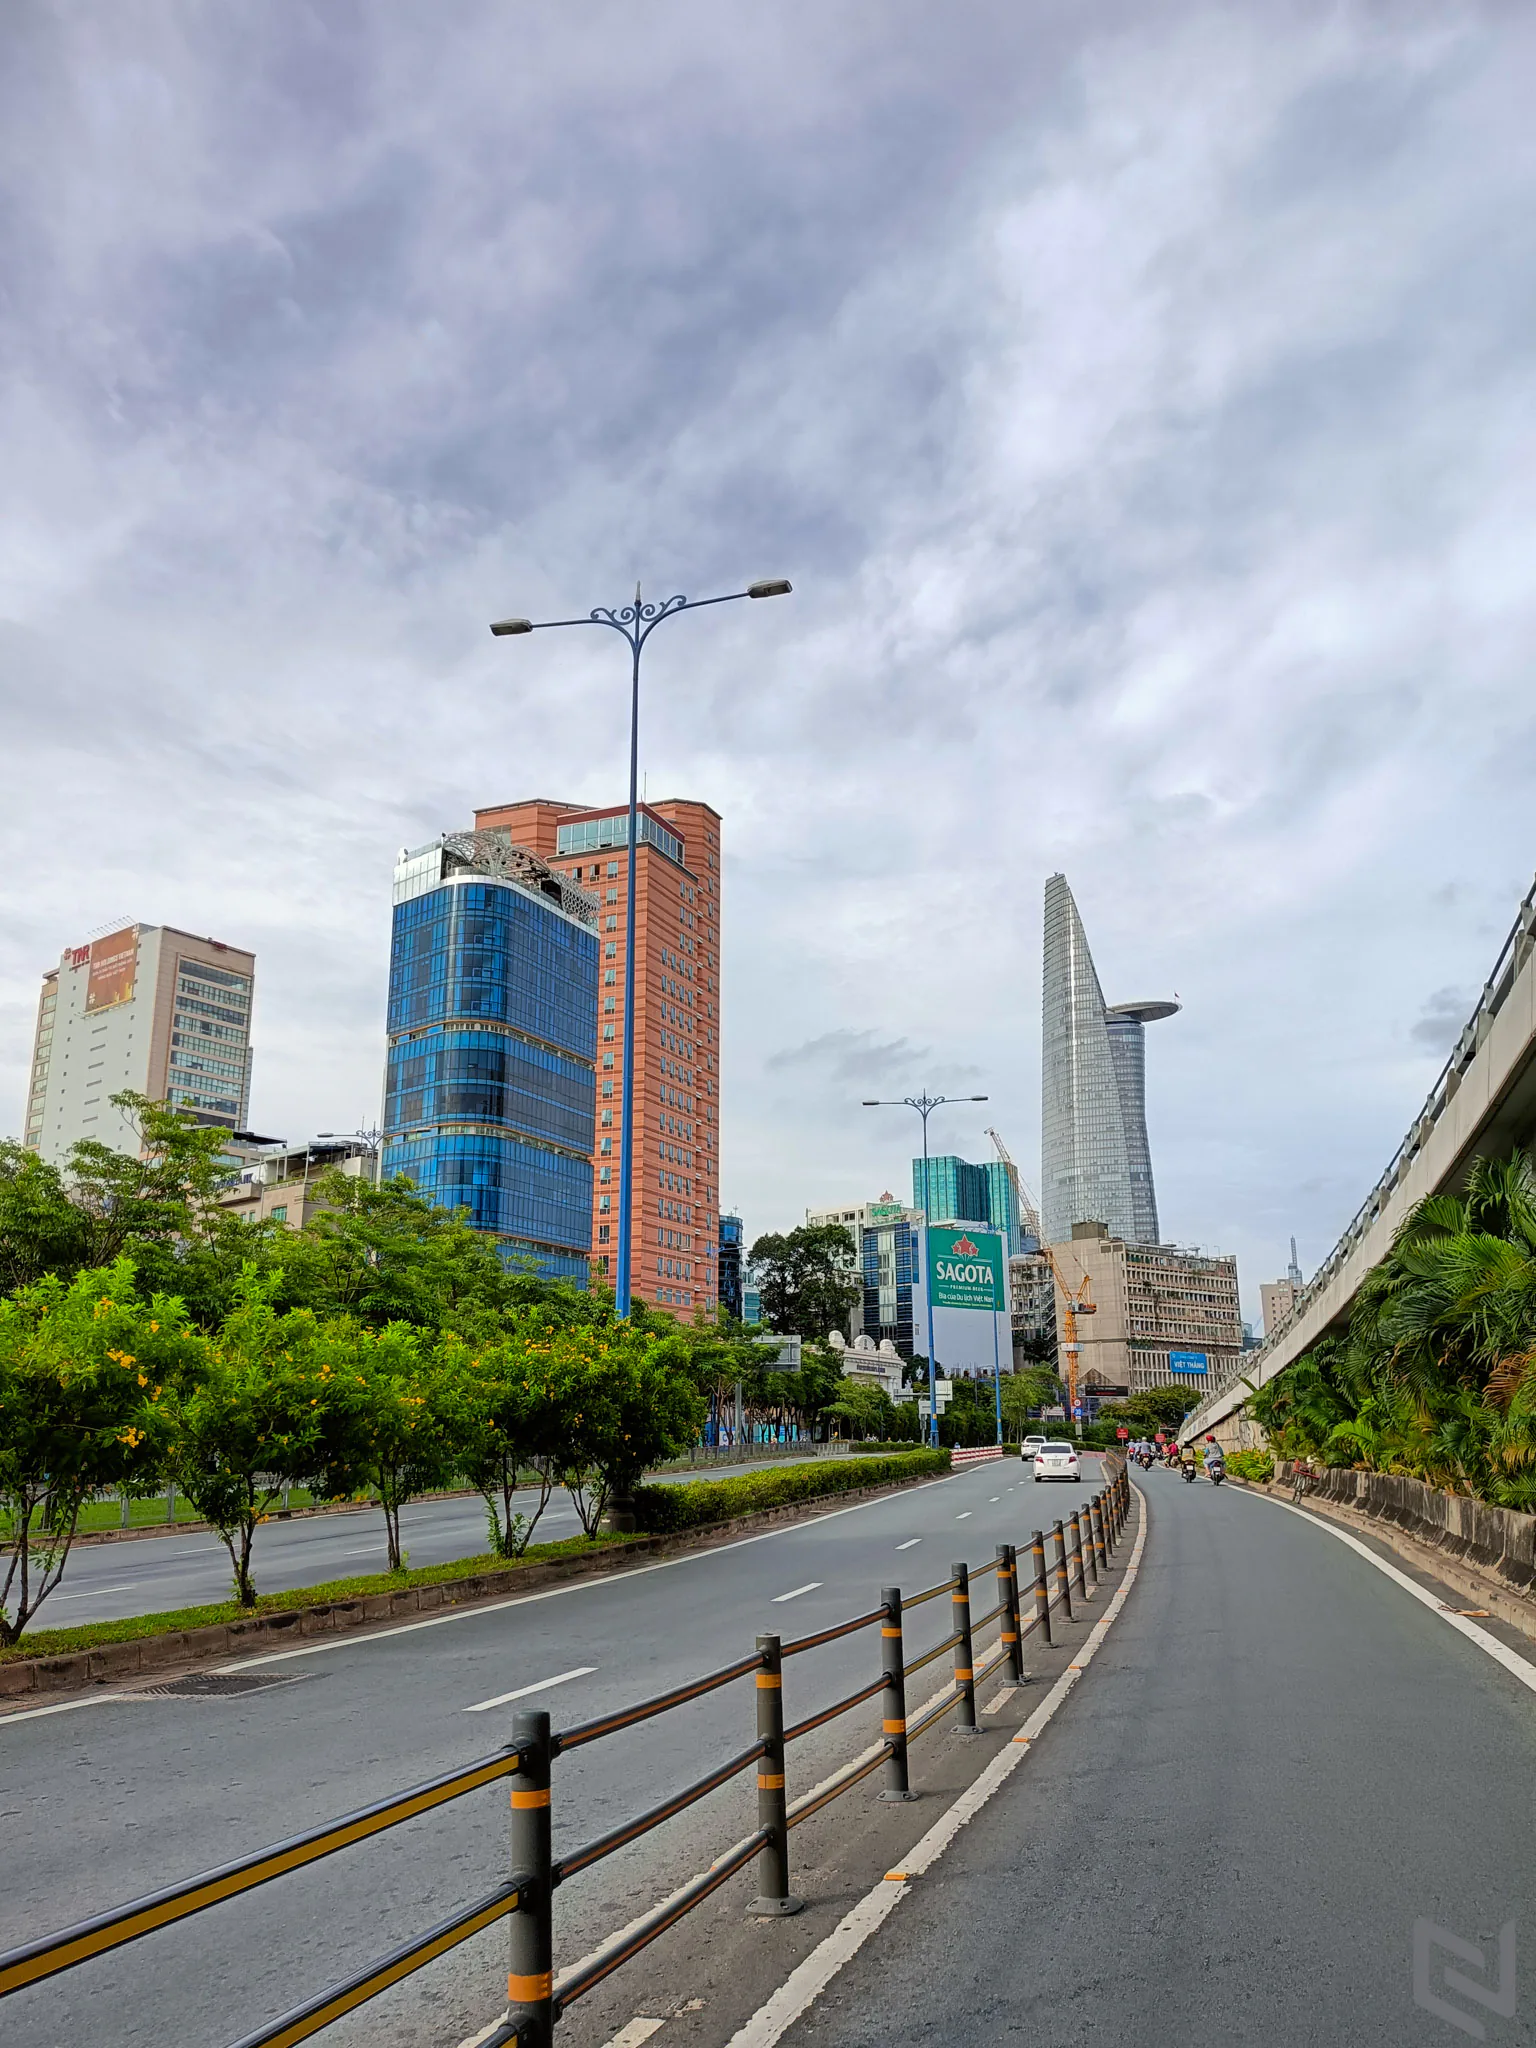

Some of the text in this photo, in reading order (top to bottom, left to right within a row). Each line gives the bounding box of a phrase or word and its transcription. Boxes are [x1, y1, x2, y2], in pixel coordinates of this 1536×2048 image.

[72, 944, 90, 965] TNR
[936, 1261, 994, 1284] SAGOTA
[973, 1295, 983, 1303] Việt
